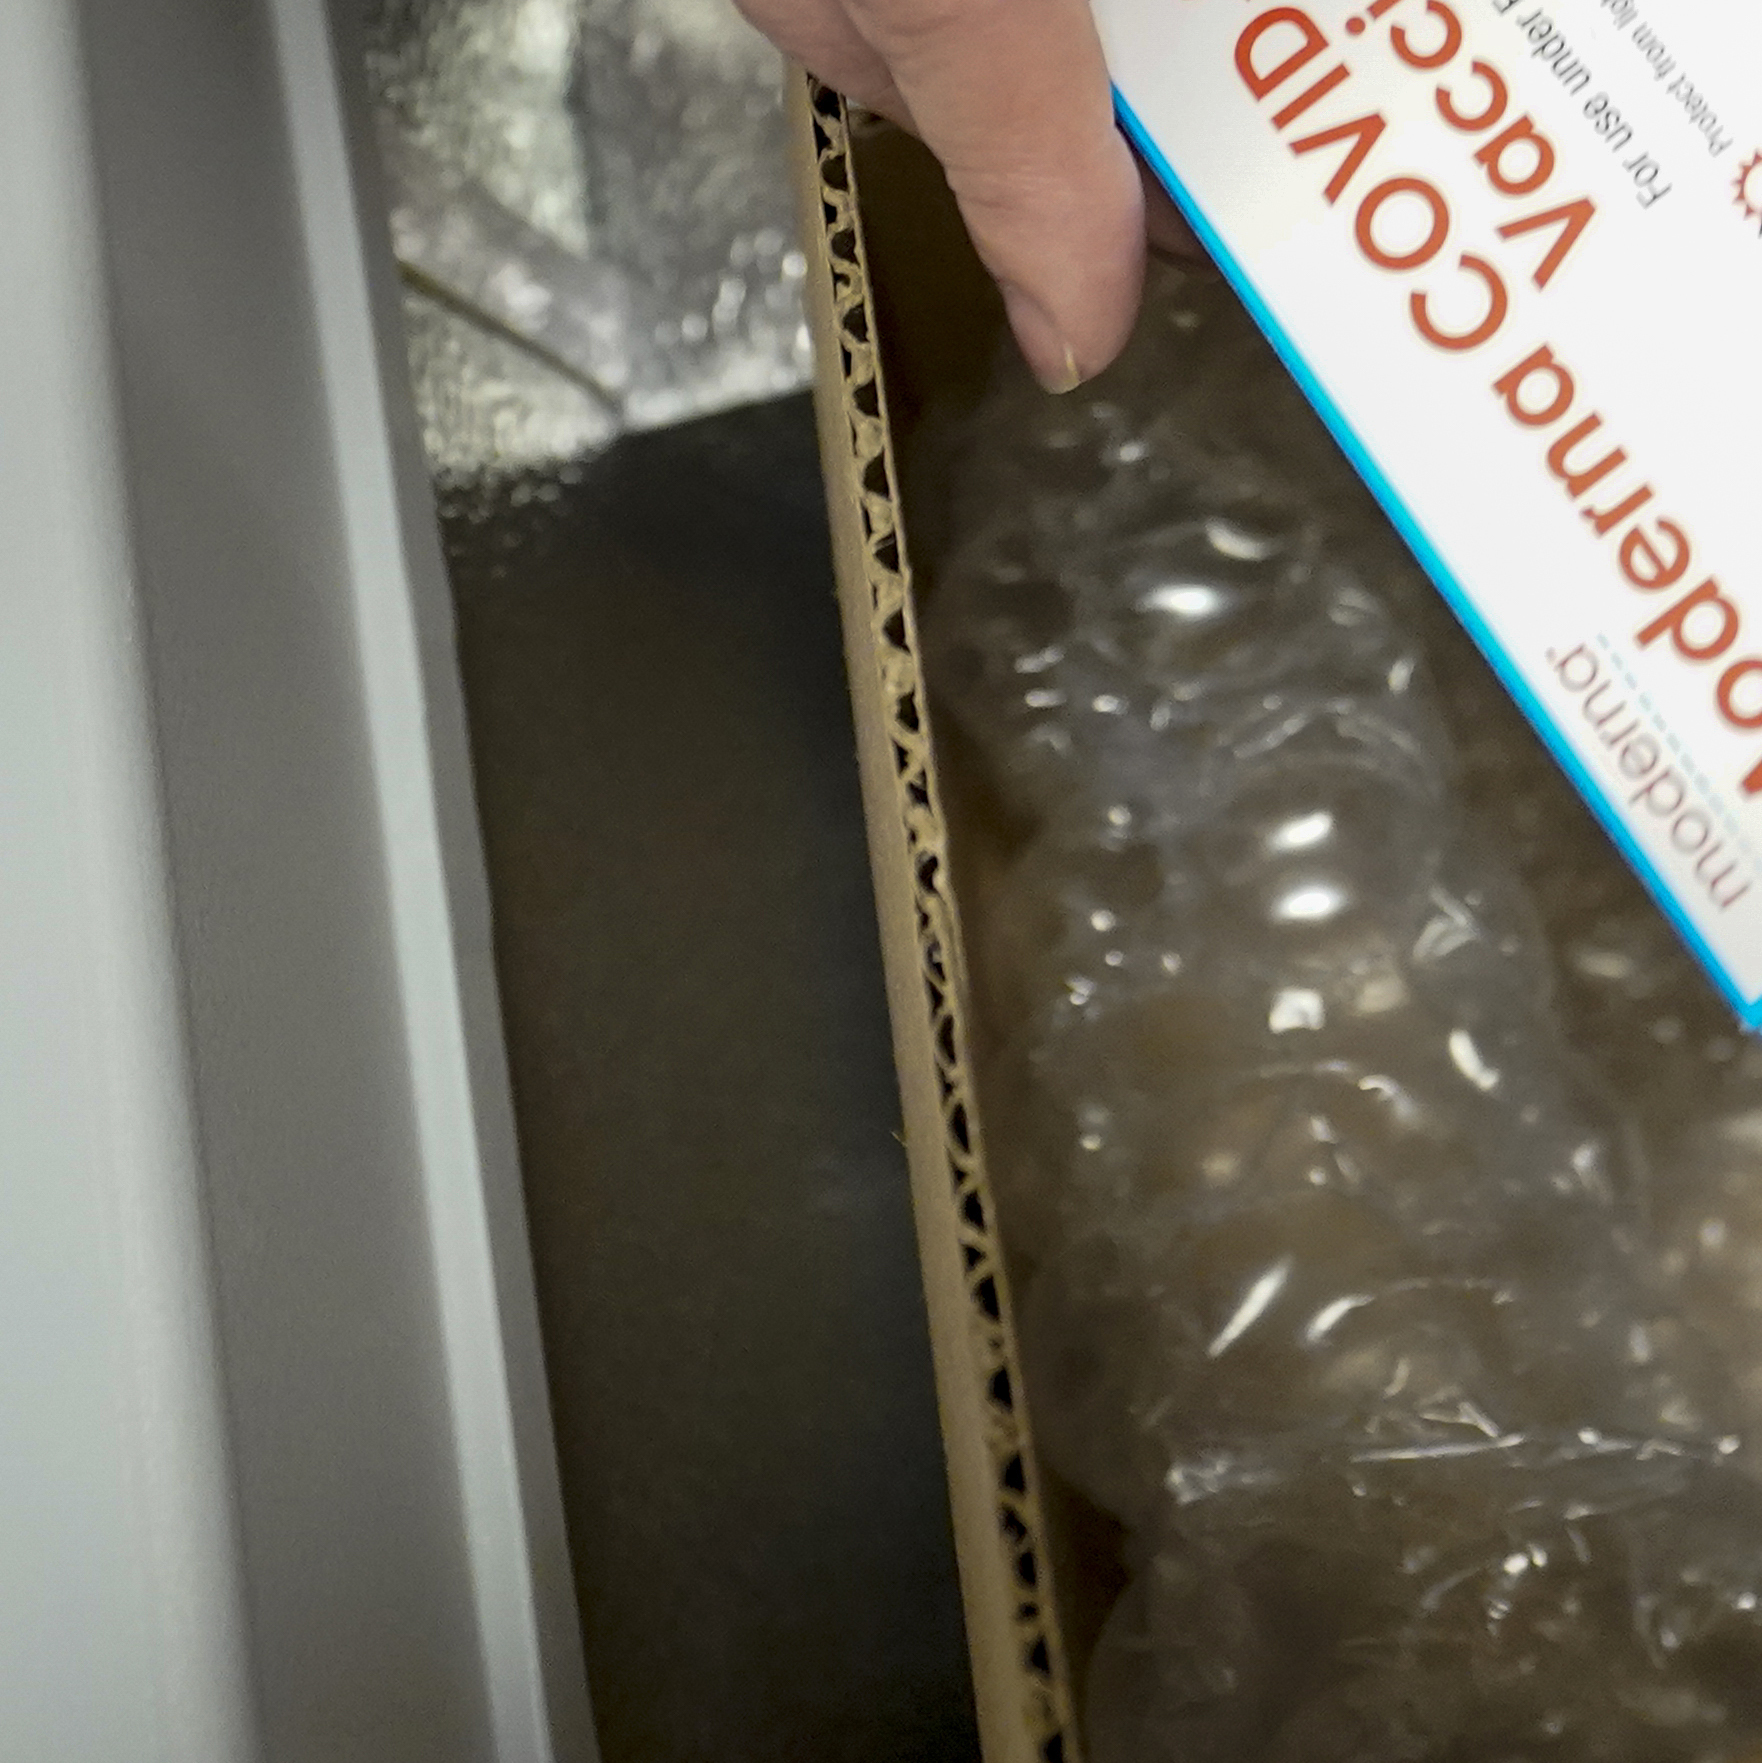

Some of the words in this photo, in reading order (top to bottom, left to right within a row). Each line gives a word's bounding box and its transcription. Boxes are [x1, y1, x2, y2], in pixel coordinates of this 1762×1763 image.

[1516, 9, 1591, 95] under
[1631, 23, 1676, 81] from
[1583, 95, 1633, 151] use
[1666, 73, 1733, 157] Protect
[1623, 153, 1672, 209] For
[1549, 643, 1753, 913] moderna
